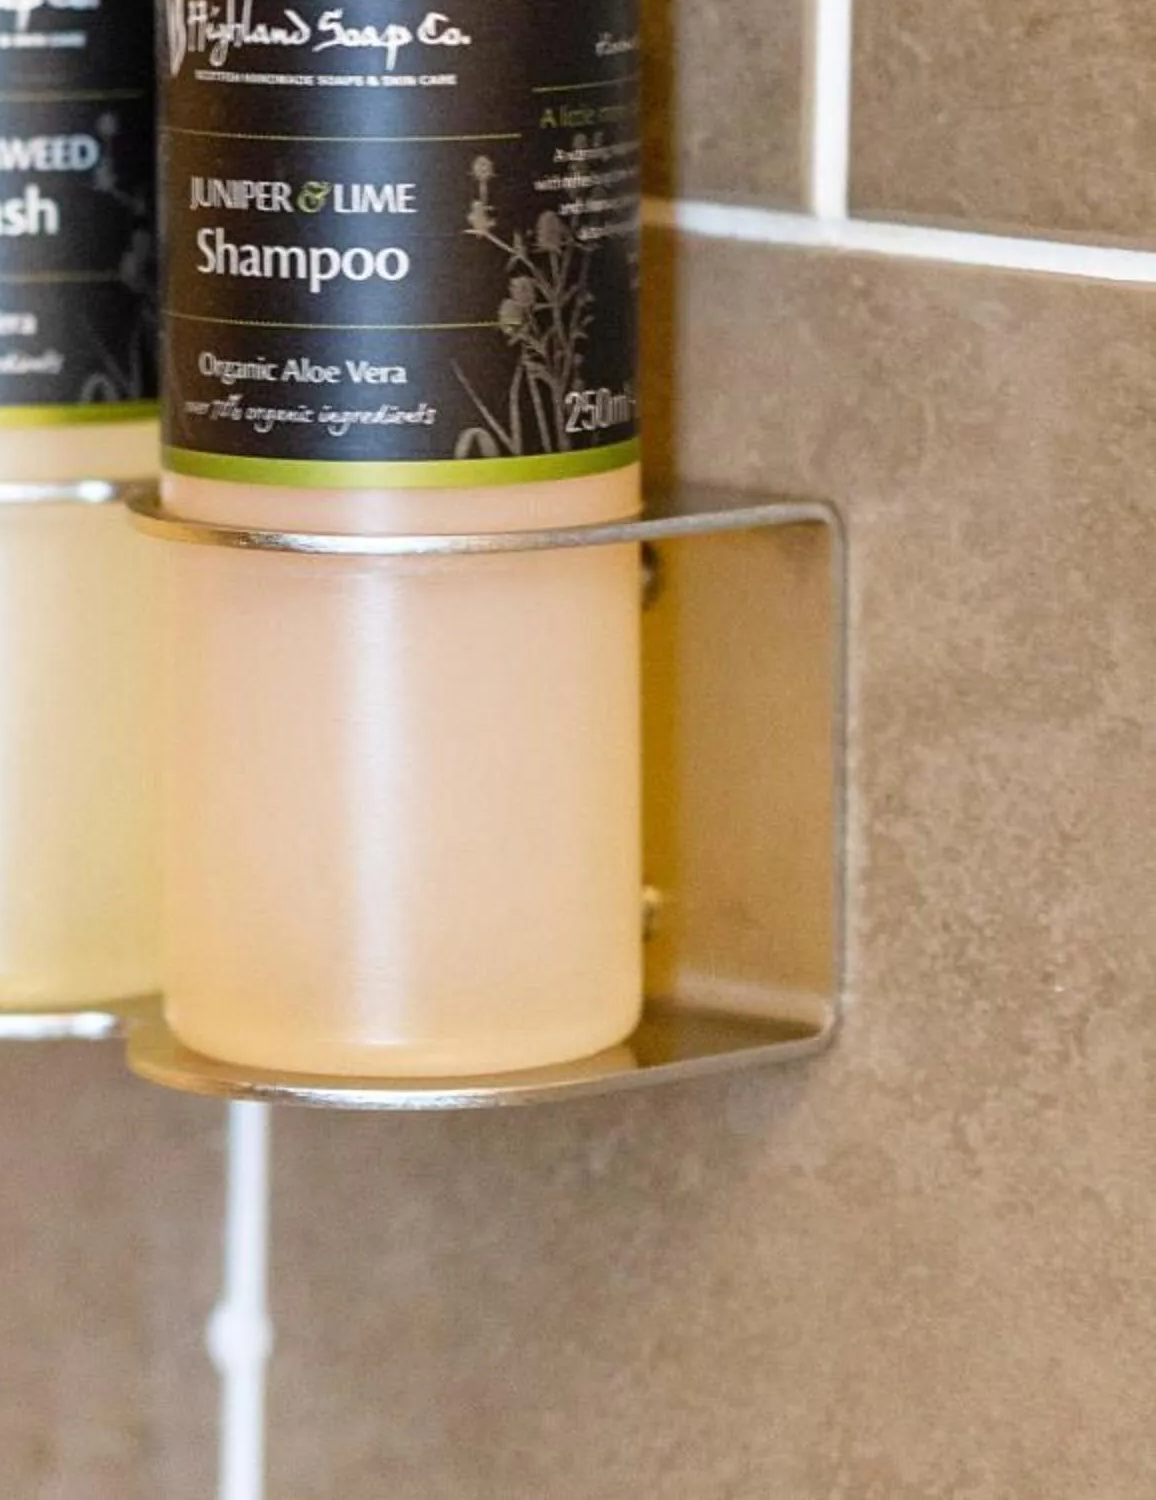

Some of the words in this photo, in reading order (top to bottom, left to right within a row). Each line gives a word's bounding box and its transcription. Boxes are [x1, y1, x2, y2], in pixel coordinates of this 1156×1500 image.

[312, 8, 413, 71] Soap
[416, 11, 472, 46] Co.
[189, 176, 294, 212] JUNIPER
[297, 180, 332, 213] &
[333, 183, 419, 214] LIME
[197, 227, 410, 293] Shampoo
[198, 351, 278, 385] Organic
[279, 357, 341, 384] Aloe
[345, 360, 408, 384] Vera
